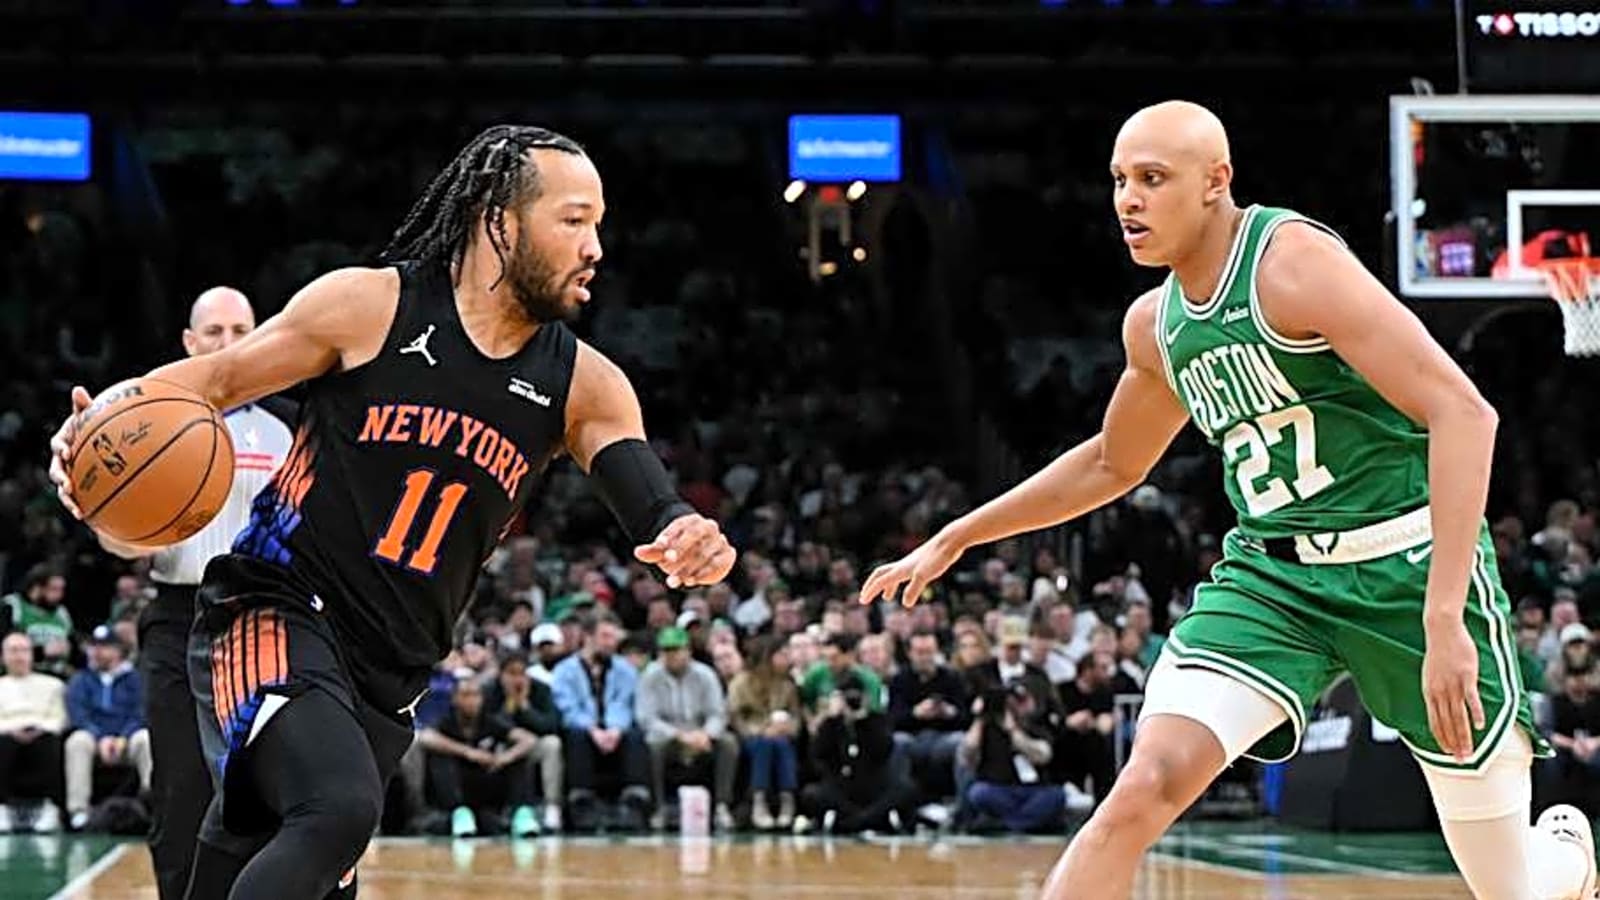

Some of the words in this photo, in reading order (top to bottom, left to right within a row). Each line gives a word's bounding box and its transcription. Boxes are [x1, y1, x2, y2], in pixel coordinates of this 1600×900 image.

[1513, 12, 1600, 37] TISSO
[1178, 343, 1301, 438] BOSTON
[357, 404, 459, 447] NEW
[455, 414, 529, 500] YORK
[1222, 404, 1336, 518] 27
[372, 467, 470, 574] 11
